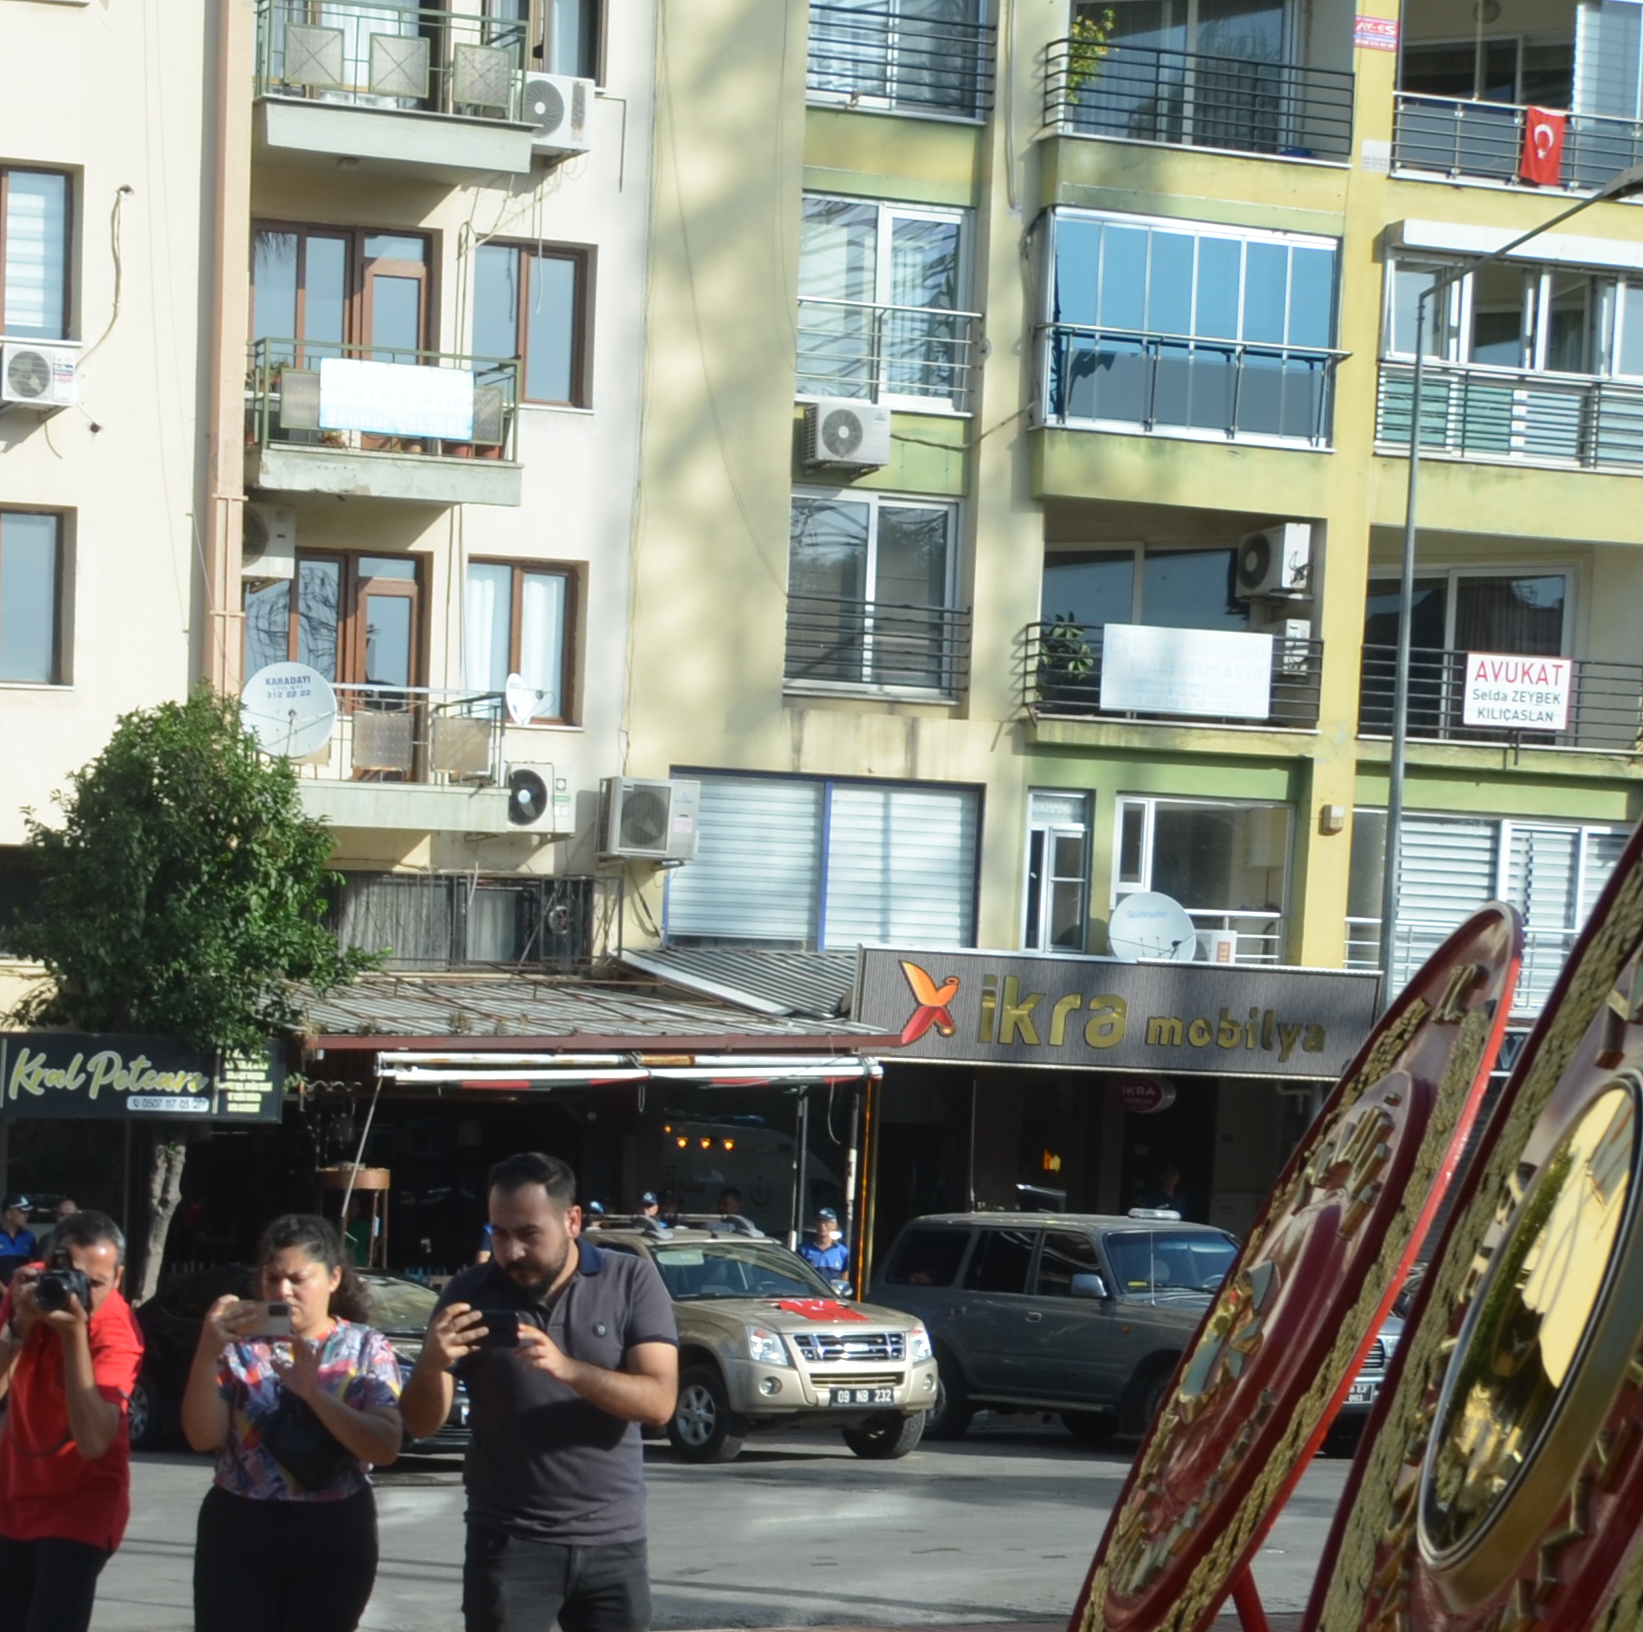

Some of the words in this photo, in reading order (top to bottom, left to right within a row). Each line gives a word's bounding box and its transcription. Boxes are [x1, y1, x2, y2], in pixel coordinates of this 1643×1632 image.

[1475, 660, 1564, 686] AVUKAT
[1472, 688, 1508, 702] Selda
[1512, 690, 1561, 705] ZEYBEK
[977, 973, 1128, 1050] ikra
[1146, 1006, 1327, 1063] mobilya
[8, 1047, 87, 1101] Kral
[85, 1050, 210, 1101] Petcare
[837, 1389, 851, 1404] 09
[874, 1388, 892, 1403] 232
